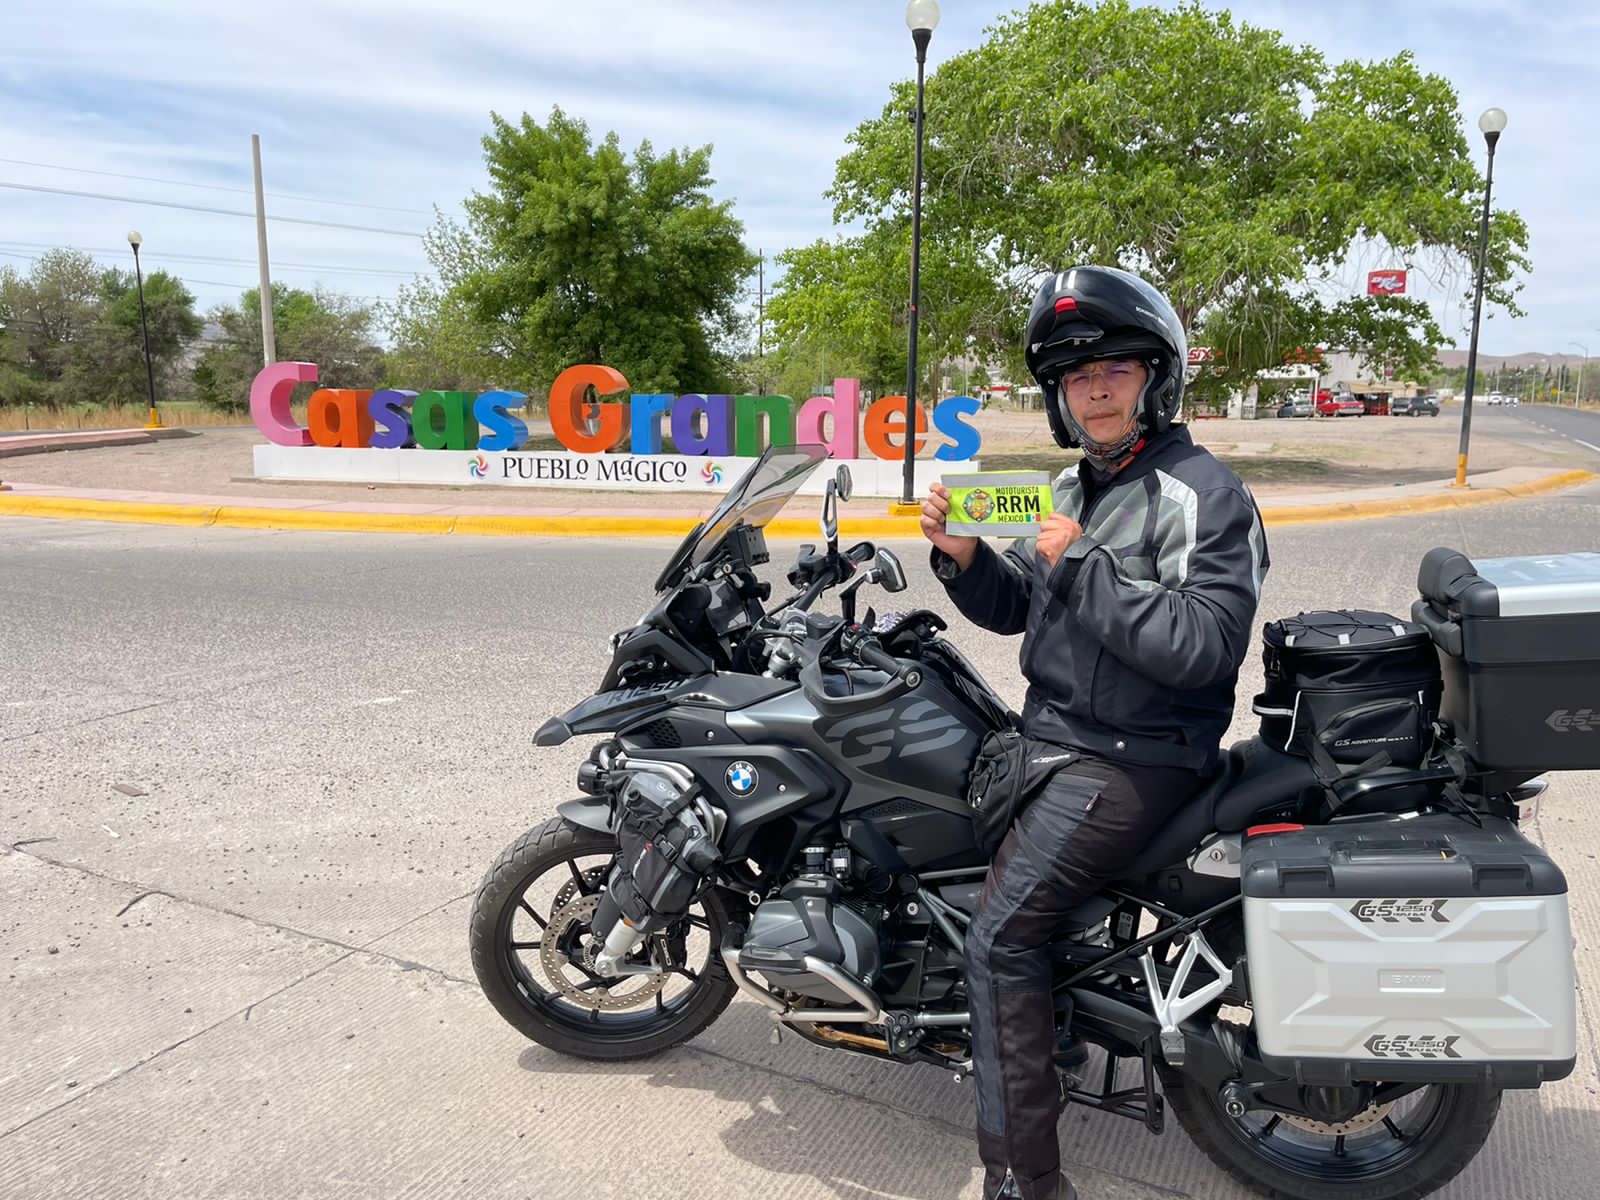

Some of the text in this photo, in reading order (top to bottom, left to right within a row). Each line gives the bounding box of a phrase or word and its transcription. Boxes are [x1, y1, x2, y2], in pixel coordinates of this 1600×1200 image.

[251, 361, 982, 462] Casas Grandes
[996, 486, 1039, 495] MOTOTURISTA
[997, 495, 1040, 513] RRM
